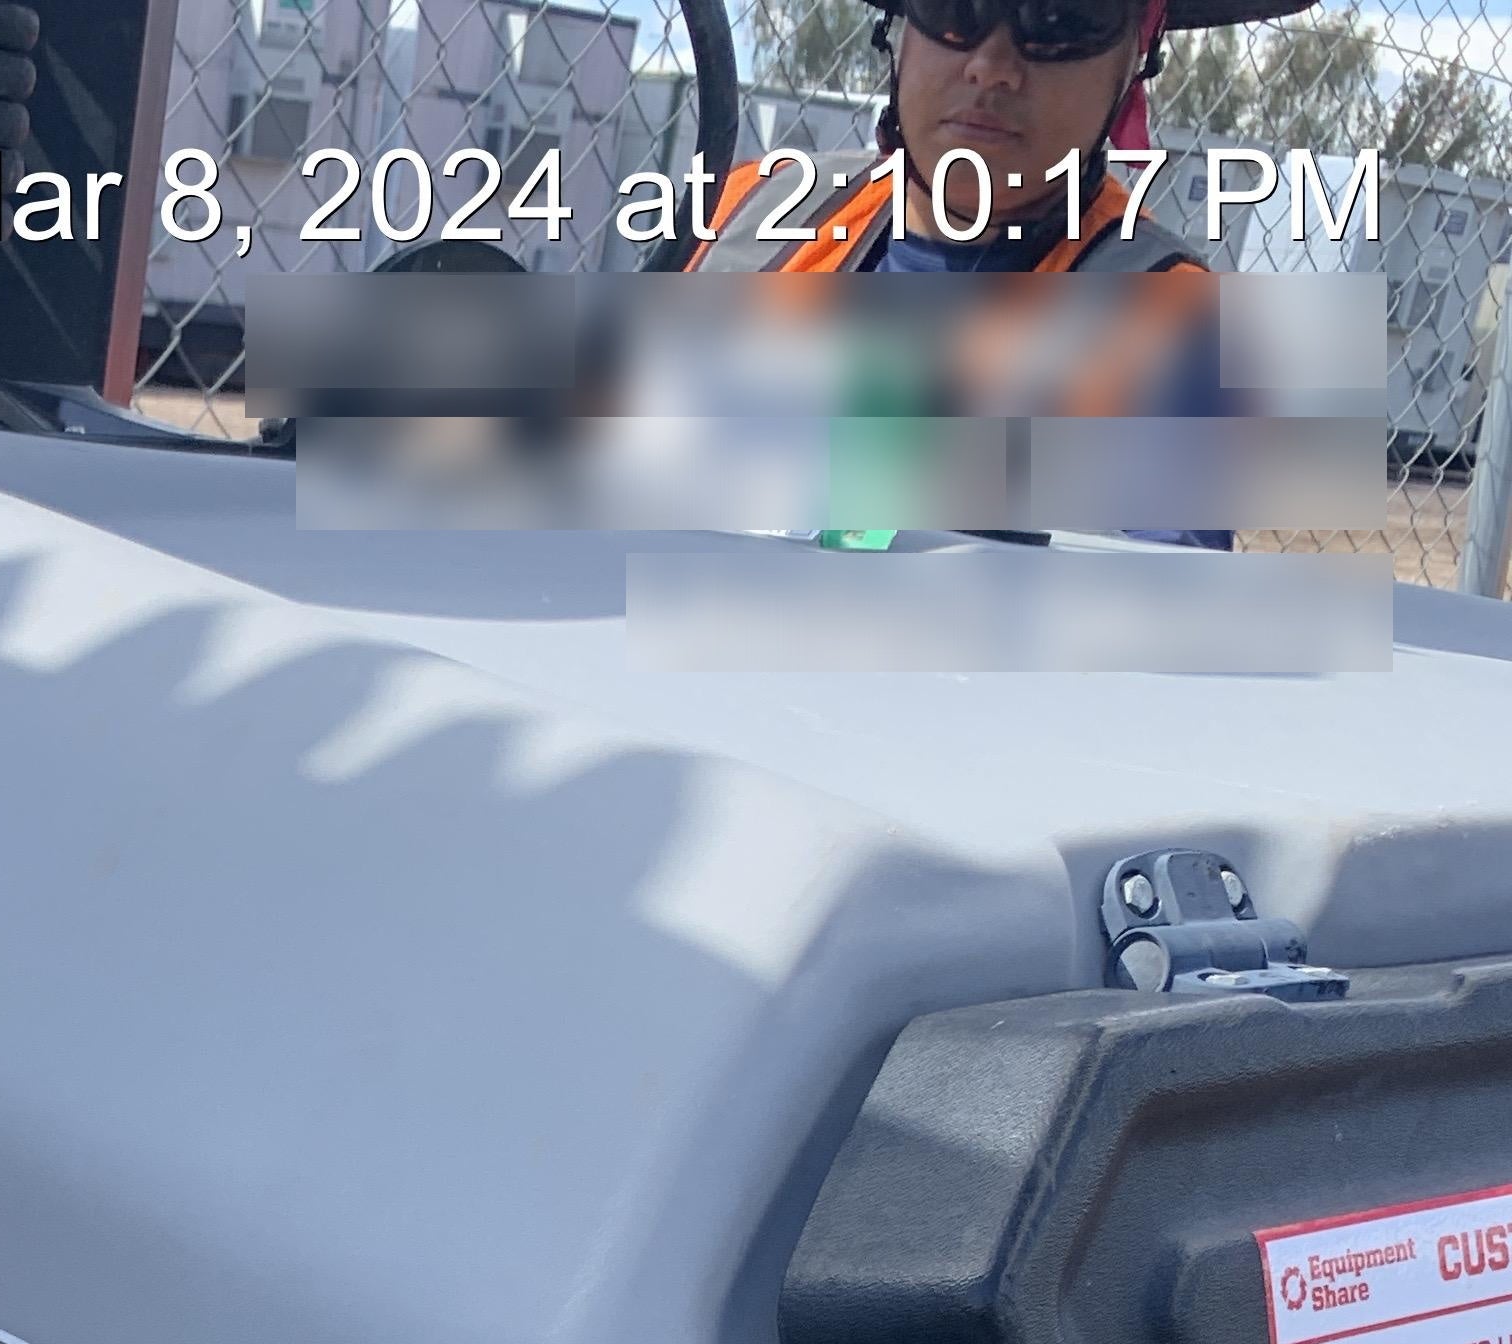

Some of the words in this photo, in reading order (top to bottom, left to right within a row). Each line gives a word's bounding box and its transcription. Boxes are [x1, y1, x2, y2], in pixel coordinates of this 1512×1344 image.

[1308, 1236, 1417, 1284] Equipment
[1437, 1222, 1512, 1282] CUS
[1311, 1280, 1370, 1312] Share
